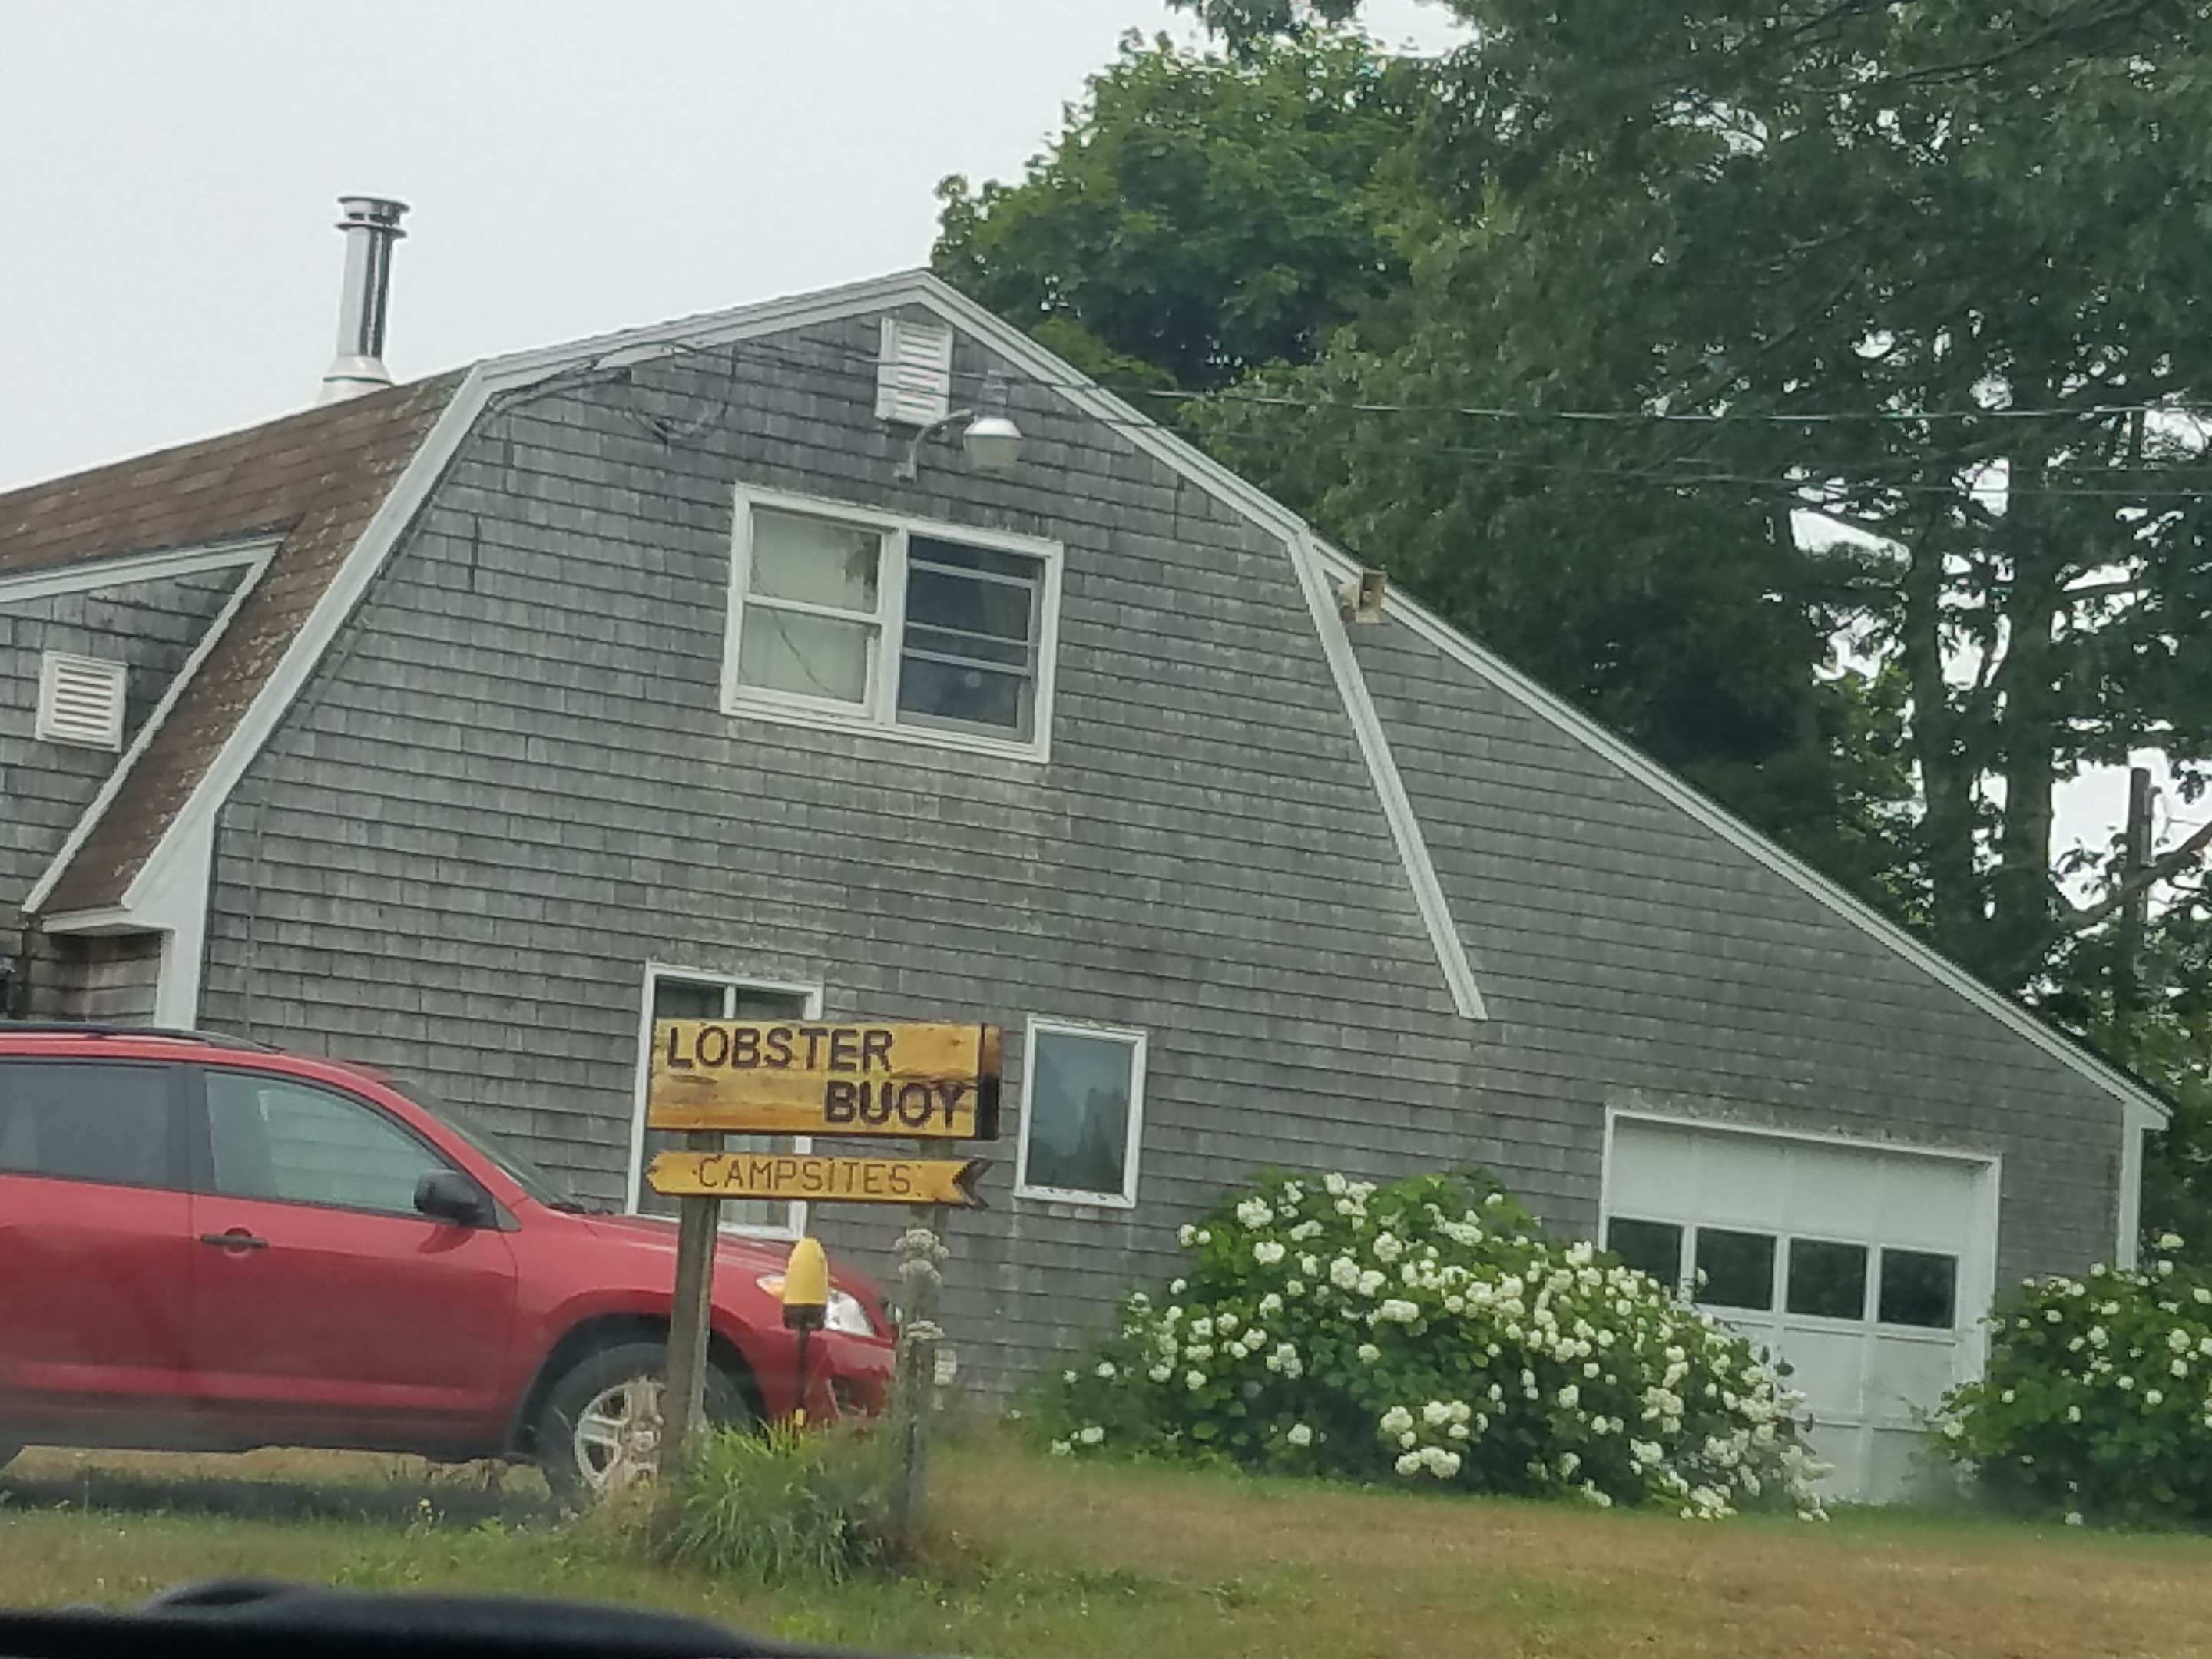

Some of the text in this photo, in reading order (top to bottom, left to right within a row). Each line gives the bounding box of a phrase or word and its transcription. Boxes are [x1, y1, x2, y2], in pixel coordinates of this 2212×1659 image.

[667, 1025, 892, 1072] LOBSTER
[825, 1080, 966, 1128] BUOY
[697, 1156, 912, 1194] CAMPSITES
